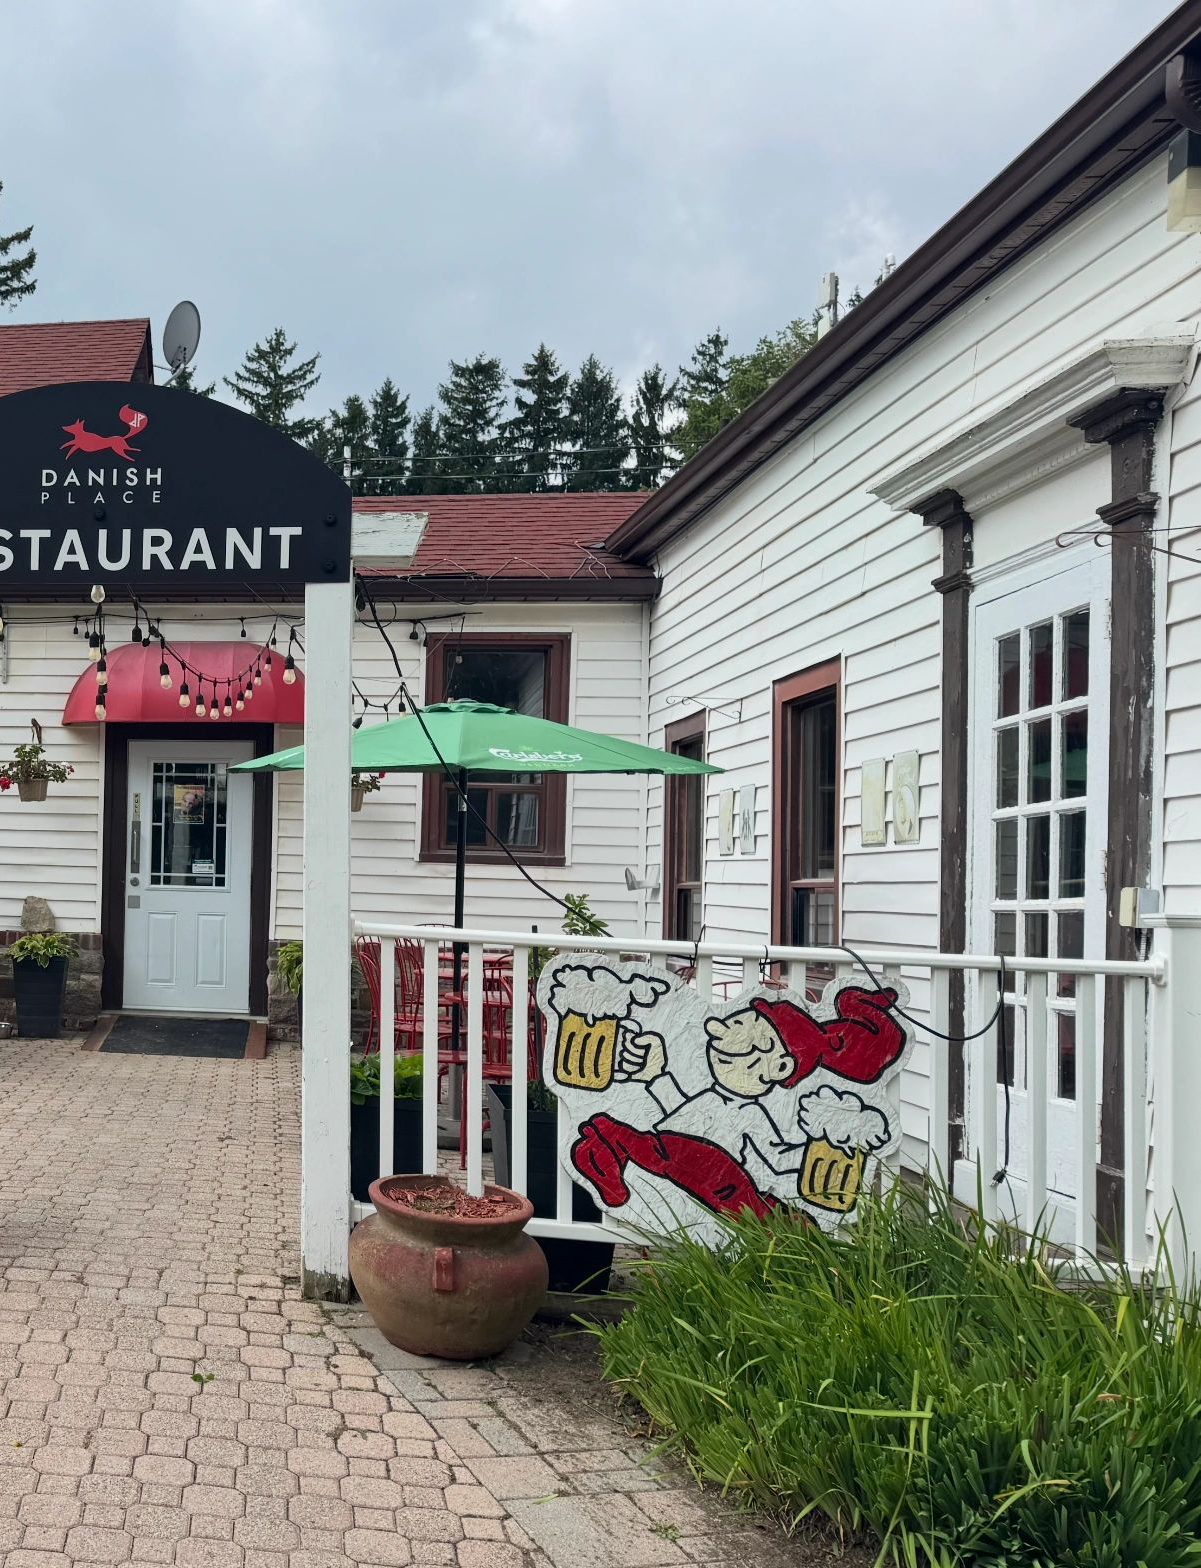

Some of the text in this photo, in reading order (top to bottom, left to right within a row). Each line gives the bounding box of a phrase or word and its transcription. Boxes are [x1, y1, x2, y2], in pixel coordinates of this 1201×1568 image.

[41, 467, 162, 487] DANISH
[41, 490, 161, 505] PLACE
[488, 748, 583, 763] Carlsberg
